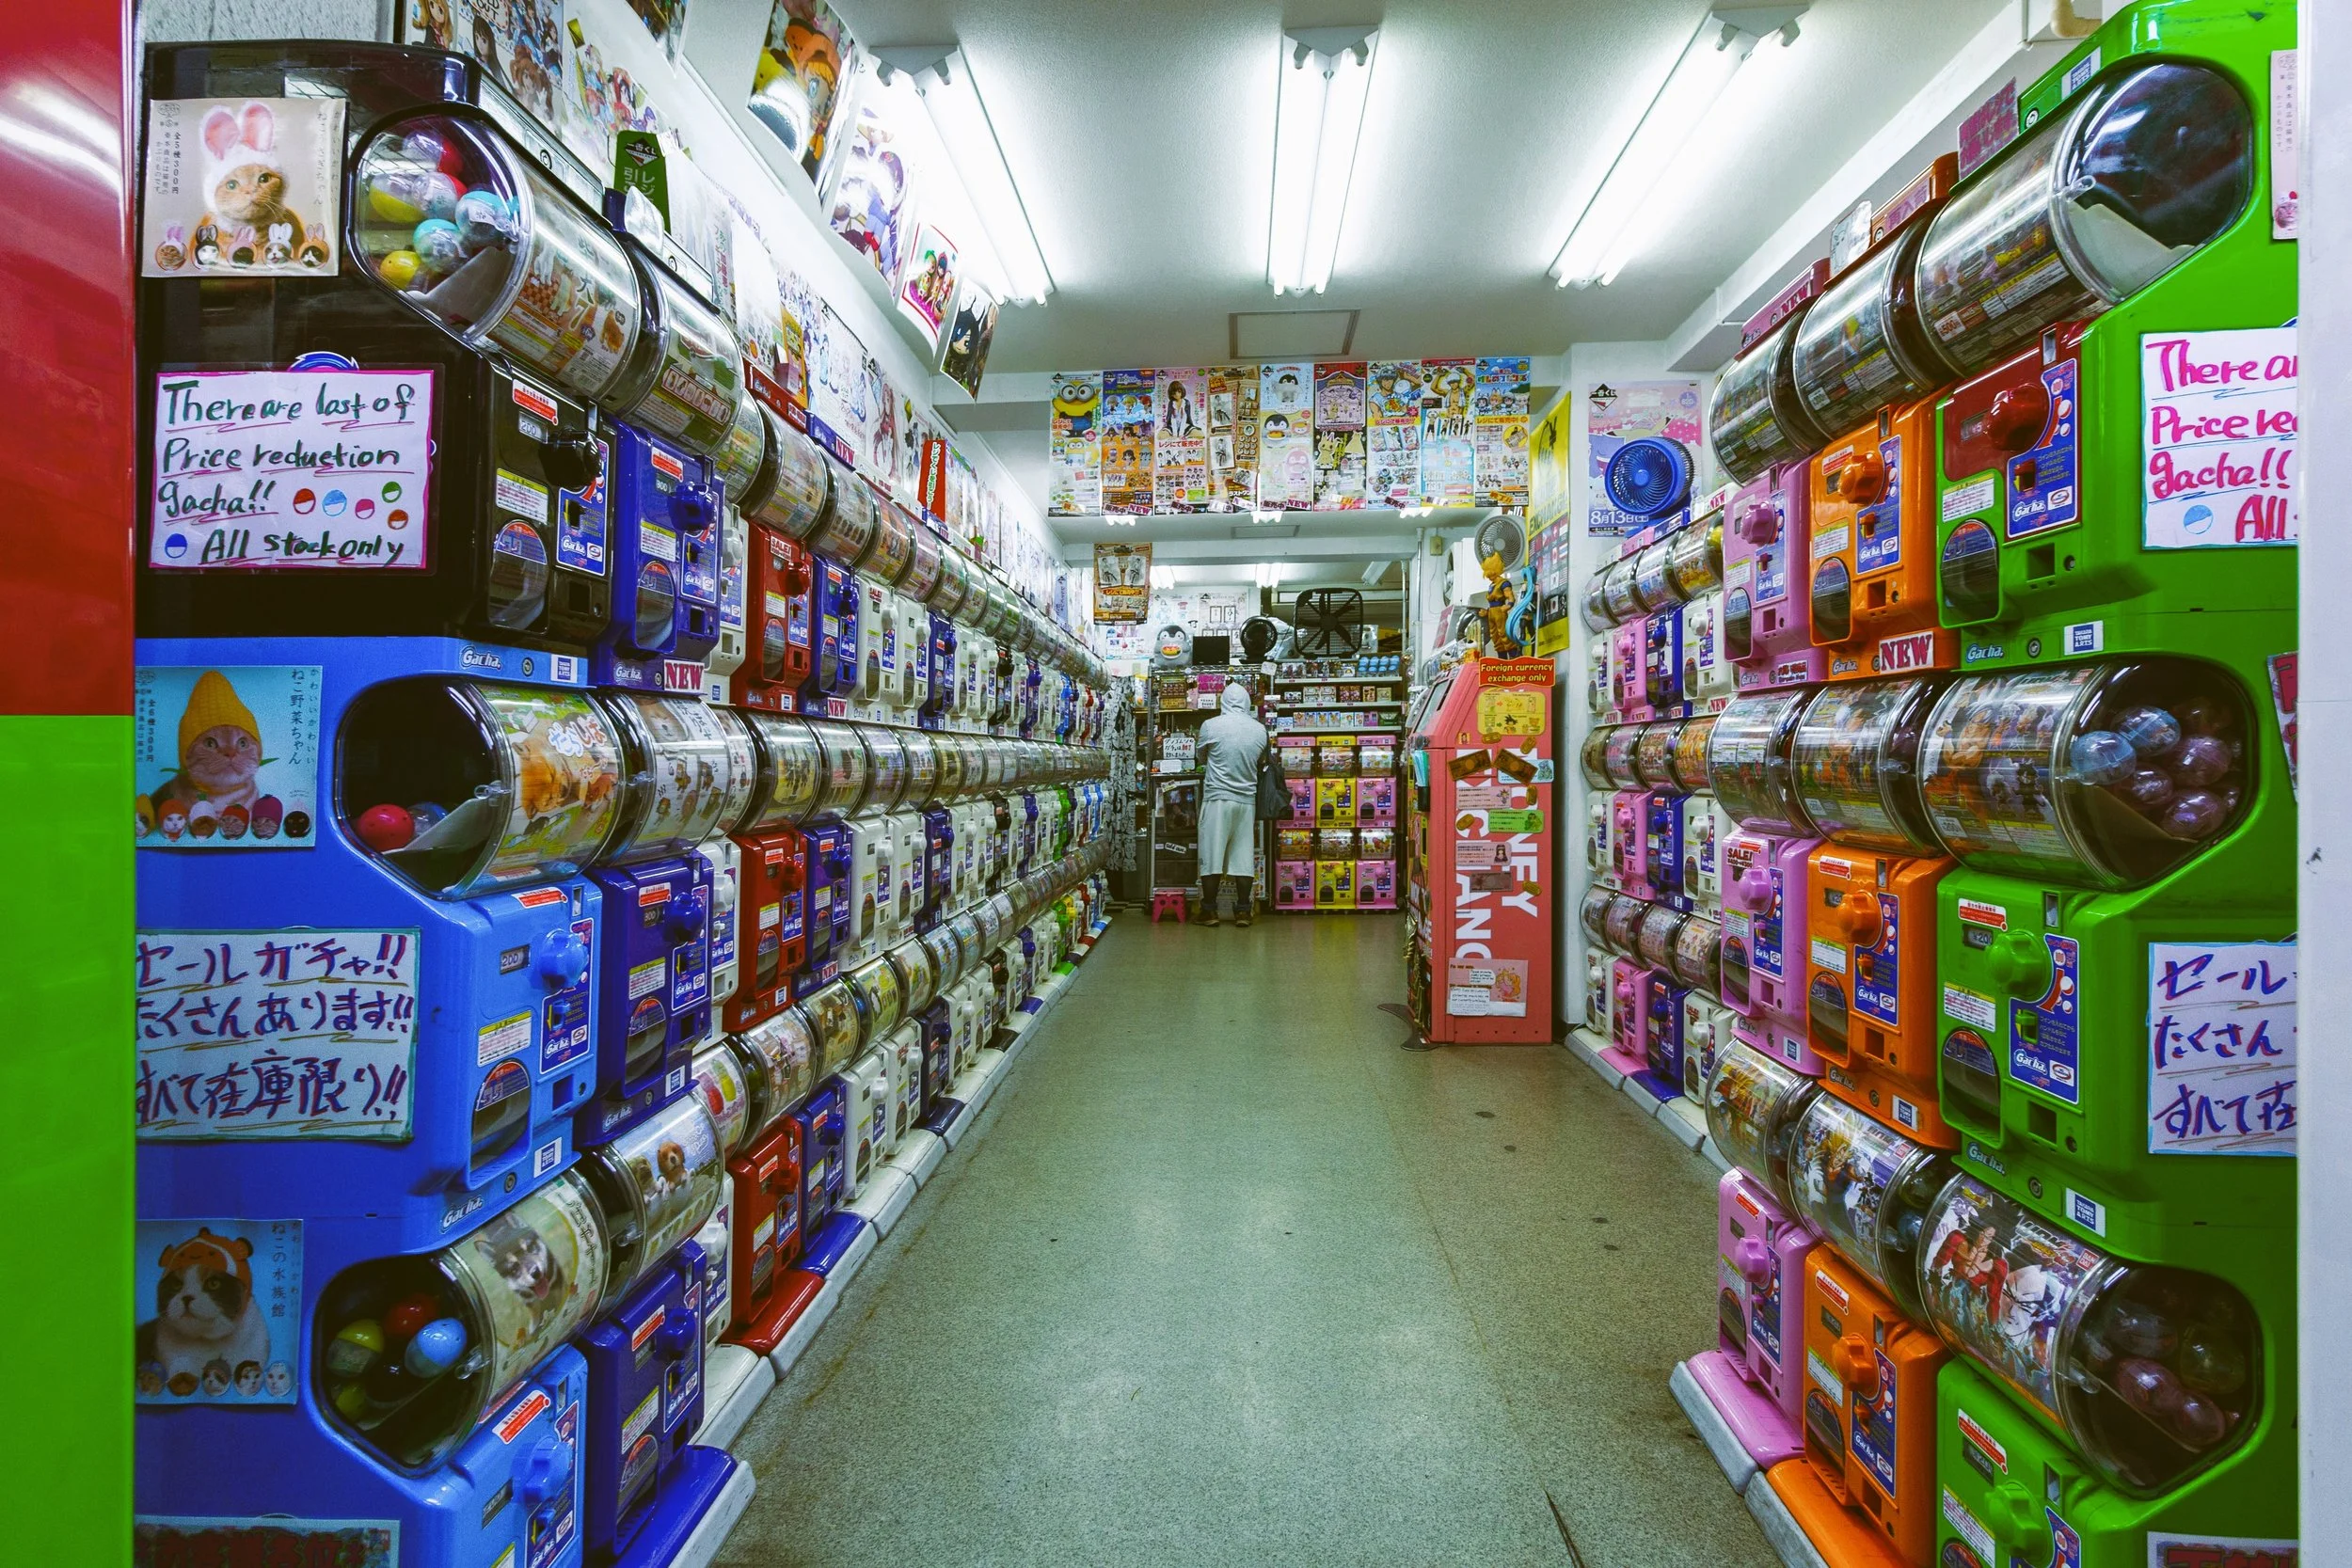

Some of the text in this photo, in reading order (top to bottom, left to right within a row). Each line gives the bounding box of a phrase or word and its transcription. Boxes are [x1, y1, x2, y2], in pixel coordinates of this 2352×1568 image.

[2146, 340, 2260, 392] There
[164, 380, 255, 425] There
[261, 400, 302, 420] are
[373, 384, 416, 422] of
[2151, 406, 2249, 445] Price
[163, 438, 401, 474] Price reduction
[836, 438, 855, 465] NEW
[2149, 448, 2293, 499] gacha!!
[158, 480, 278, 516] gacha!!
[1129, 504, 1151, 515] NEW
[1287, 499, 1309, 509] NEW
[2235, 495, 2288, 543] All
[201, 529, 405, 567] All stock only
[771, 537, 791, 555] SALE!
[1481, 663, 1553, 673] Foreign currency
[1880, 635, 1932, 671] NEW
[665, 663, 704, 690] NEW
[1487, 673, 1547, 684] exchange only
[288, 669, 306, 766] ねこ野菜ちゃん
[307, 669, 320, 765] かわいいかわいい
[1727, 847, 1753, 862] SALE!
[2157, 954, 2297, 1000] セール
[2153, 1015, 2297, 1069] たくさん
[271, 1224, 287, 1318] ねこの水族館
